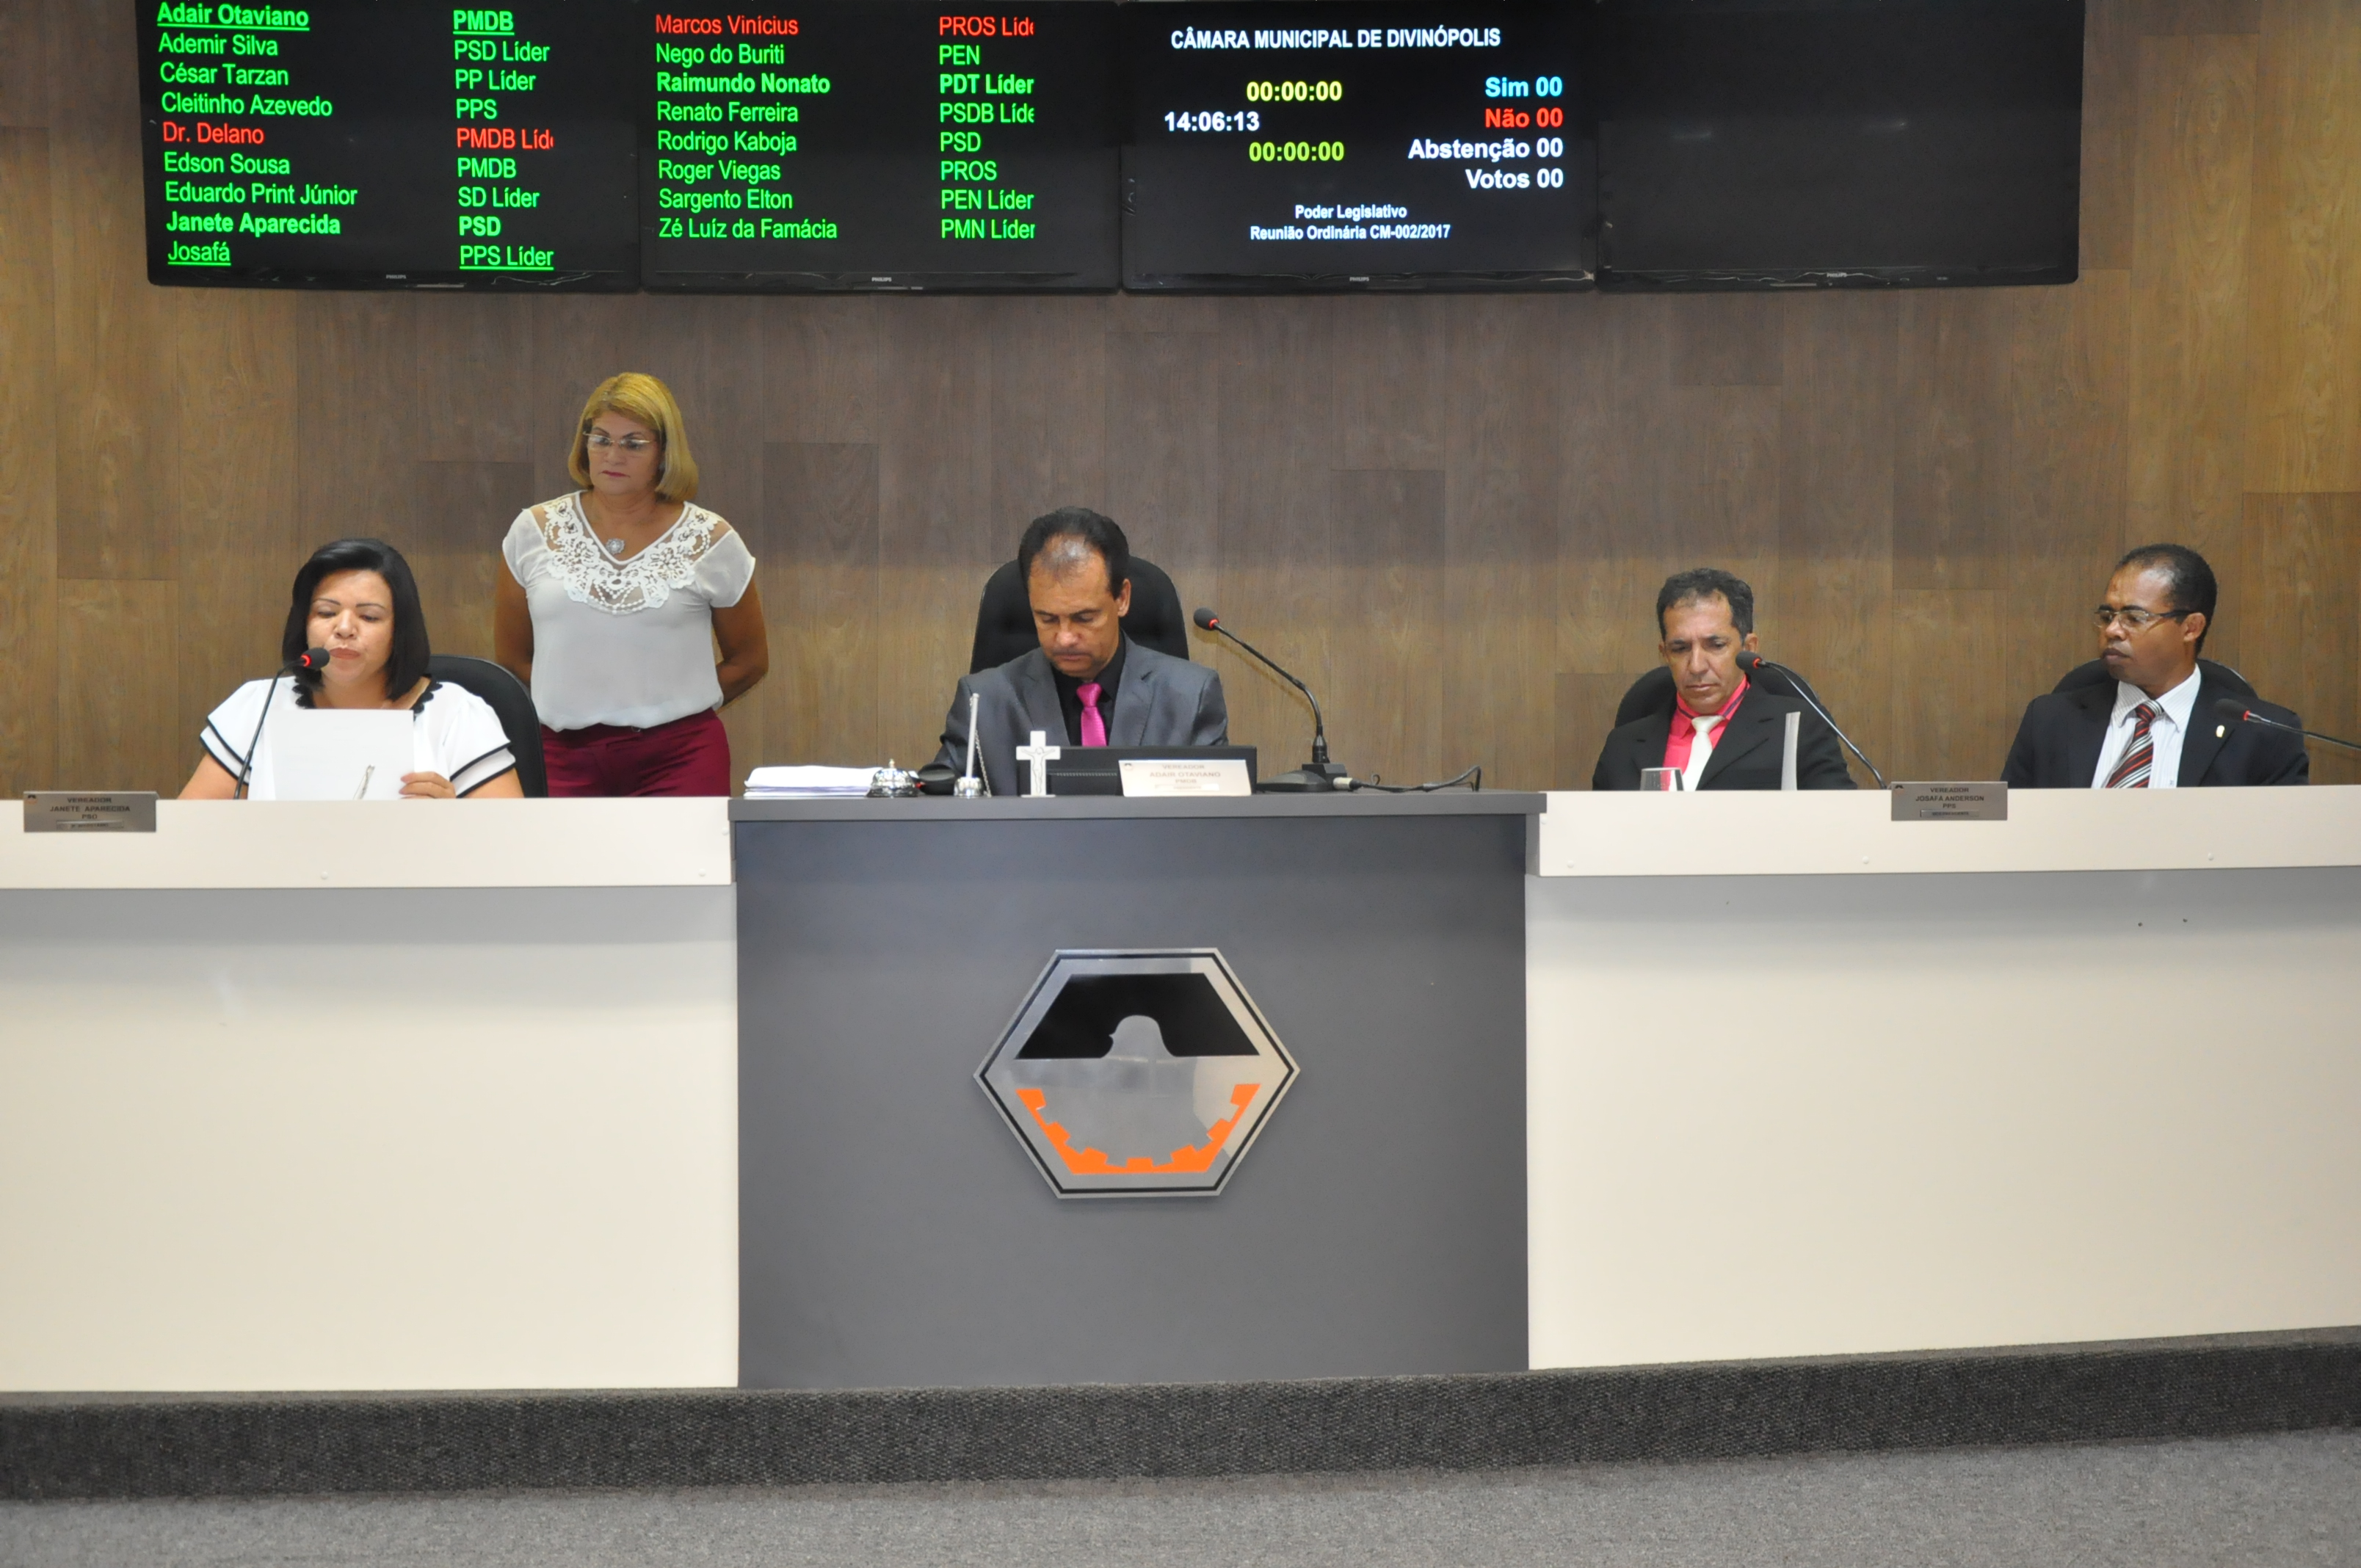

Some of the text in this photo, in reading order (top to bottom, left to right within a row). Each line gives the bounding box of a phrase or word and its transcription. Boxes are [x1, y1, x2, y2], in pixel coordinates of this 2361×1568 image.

[157, 2, 309, 26] Adair Otaviano
[453, 10, 514, 31] PMDB
[656, 15, 799, 35] Marcos Vinícius
[940, 17, 995, 36] PROS
[159, 32, 278, 56] Ademir Silva
[1172, 25, 1501, 48] CÂMARA MUNICIPAL DE DIVINÓPOLIS
[454, 40, 550, 62] PSD Líder
[656, 43, 784, 68] Nego do Buriti
[940, 45, 979, 65] PEN
[160, 62, 289, 85] César Tarzan
[455, 69, 536, 90] PP Líder
[657, 72, 830, 93] Raimundo Nonato
[940, 73, 1034, 94] PDT Líder
[1247, 81, 1342, 101] 00:00:00
[1485, 76, 1562, 98] Sim 00
[162, 92, 333, 116] Cleitinho Azevedo
[457, 98, 497, 120] PPS
[658, 101, 798, 122] Renato Ferreira
[940, 103, 994, 123] PSDB
[1164, 111, 1260, 131] 14:06:13
[1485, 107, 1563, 128] Não 00
[163, 121, 264, 144] Dr. Delano
[457, 128, 554, 150] PMDB Líd
[659, 130, 797, 156] Rodrigo Kaboja
[940, 131, 981, 152] PSD
[1250, 142, 1344, 161] 00:00:00
[1408, 137, 1564, 162] Abstenção 00
[164, 151, 290, 174] Edson Sousa
[457, 157, 517, 178] PMDB
[659, 159, 781, 185] Roger Viegas
[941, 161, 997, 181] PROS
[1465, 168, 1564, 189] Votos 00
[166, 181, 358, 205] Eduardo Print Júnior
[458, 186, 540, 208] SD Líder
[659, 188, 793, 214] Sargento Elton
[942, 189, 1034, 209] PEN Líder
[1294, 204, 1407, 222] Poder Legislativo
[167, 211, 341, 237] Janete Aparecida
[459, 216, 501, 236] PSD
[659, 218, 837, 239] Zé Luíz da Famácia
[942, 219, 1035, 239] PMN Líder
[1250, 224, 1451, 240] Reunião Ordinária CM-002/2017
[168, 241, 231, 262] Josafá
[460, 245, 554, 266] PPS Líder
